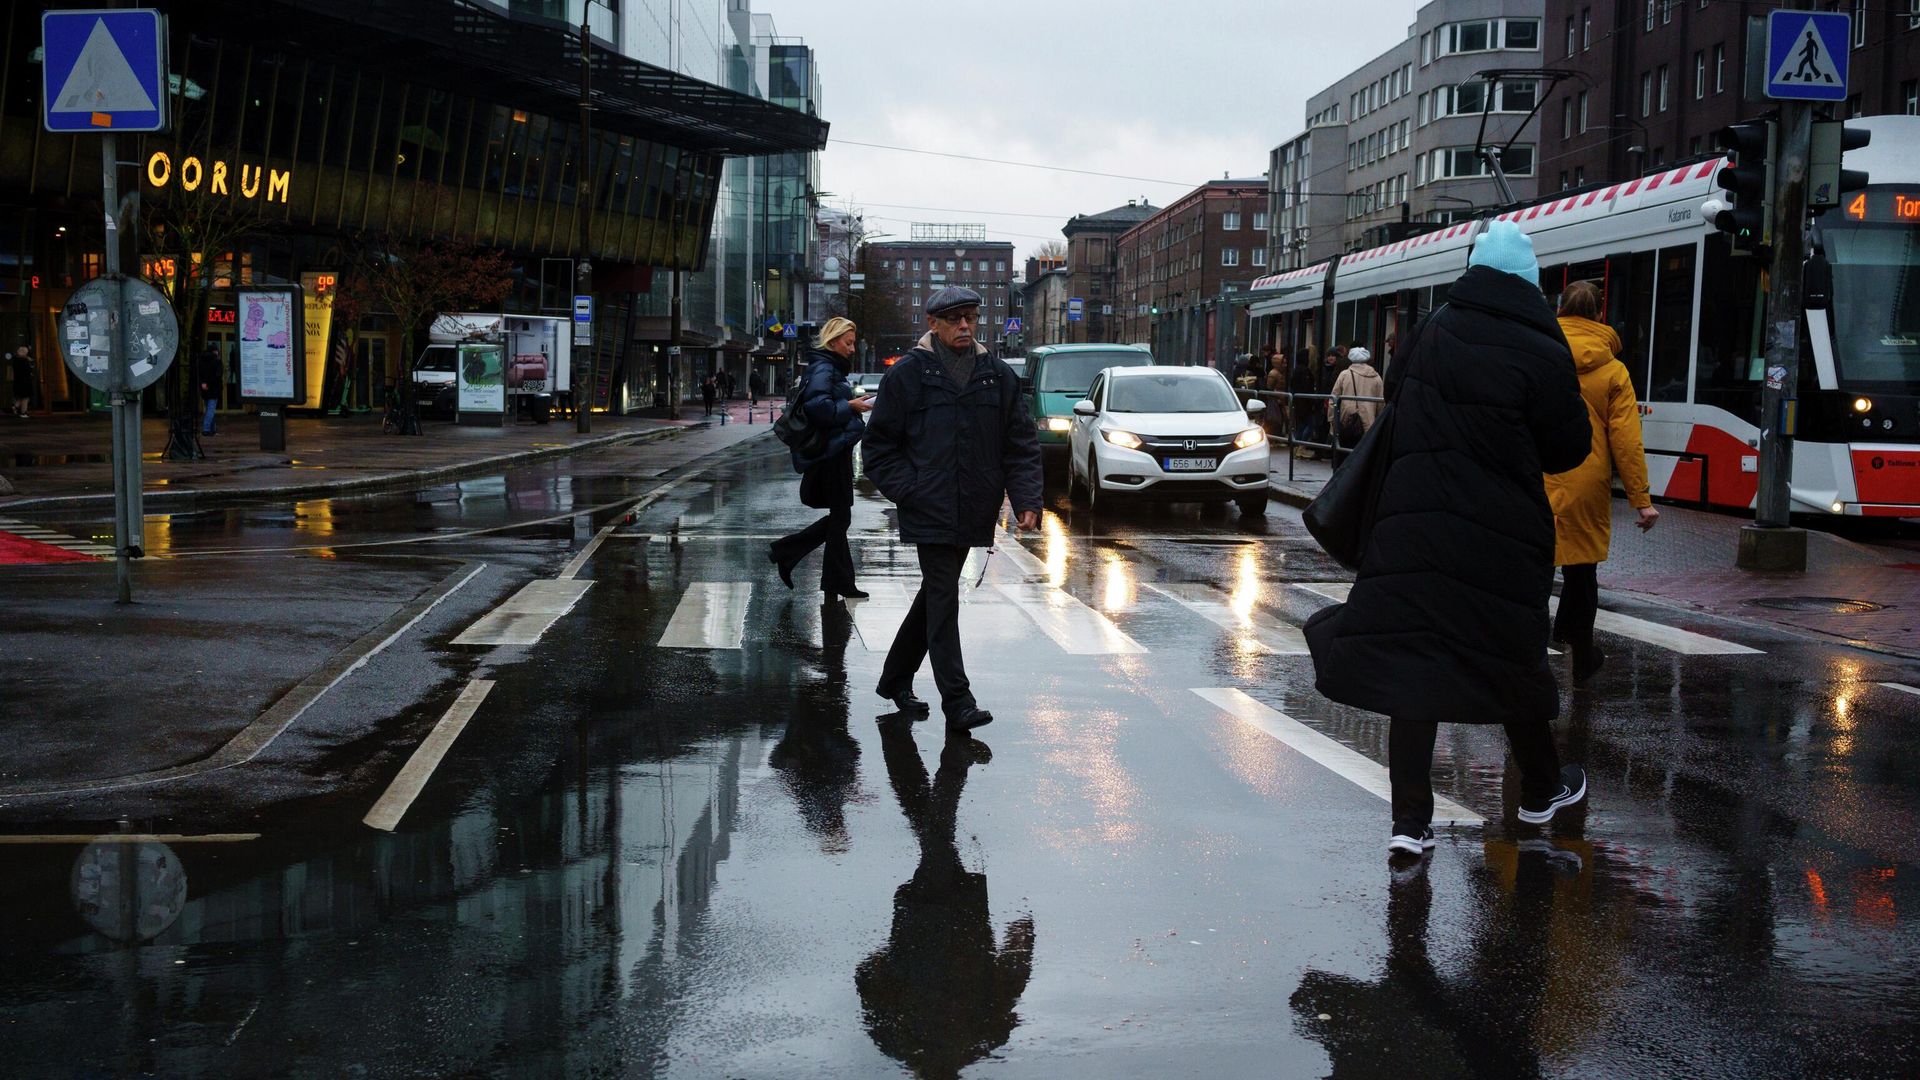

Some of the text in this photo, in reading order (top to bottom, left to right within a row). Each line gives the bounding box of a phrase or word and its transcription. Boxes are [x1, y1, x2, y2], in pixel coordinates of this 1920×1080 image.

[1849, 193, 1866, 220] 4
[1173, 460, 1189, 468] 656
[1195, 460, 1213, 468] MJX
